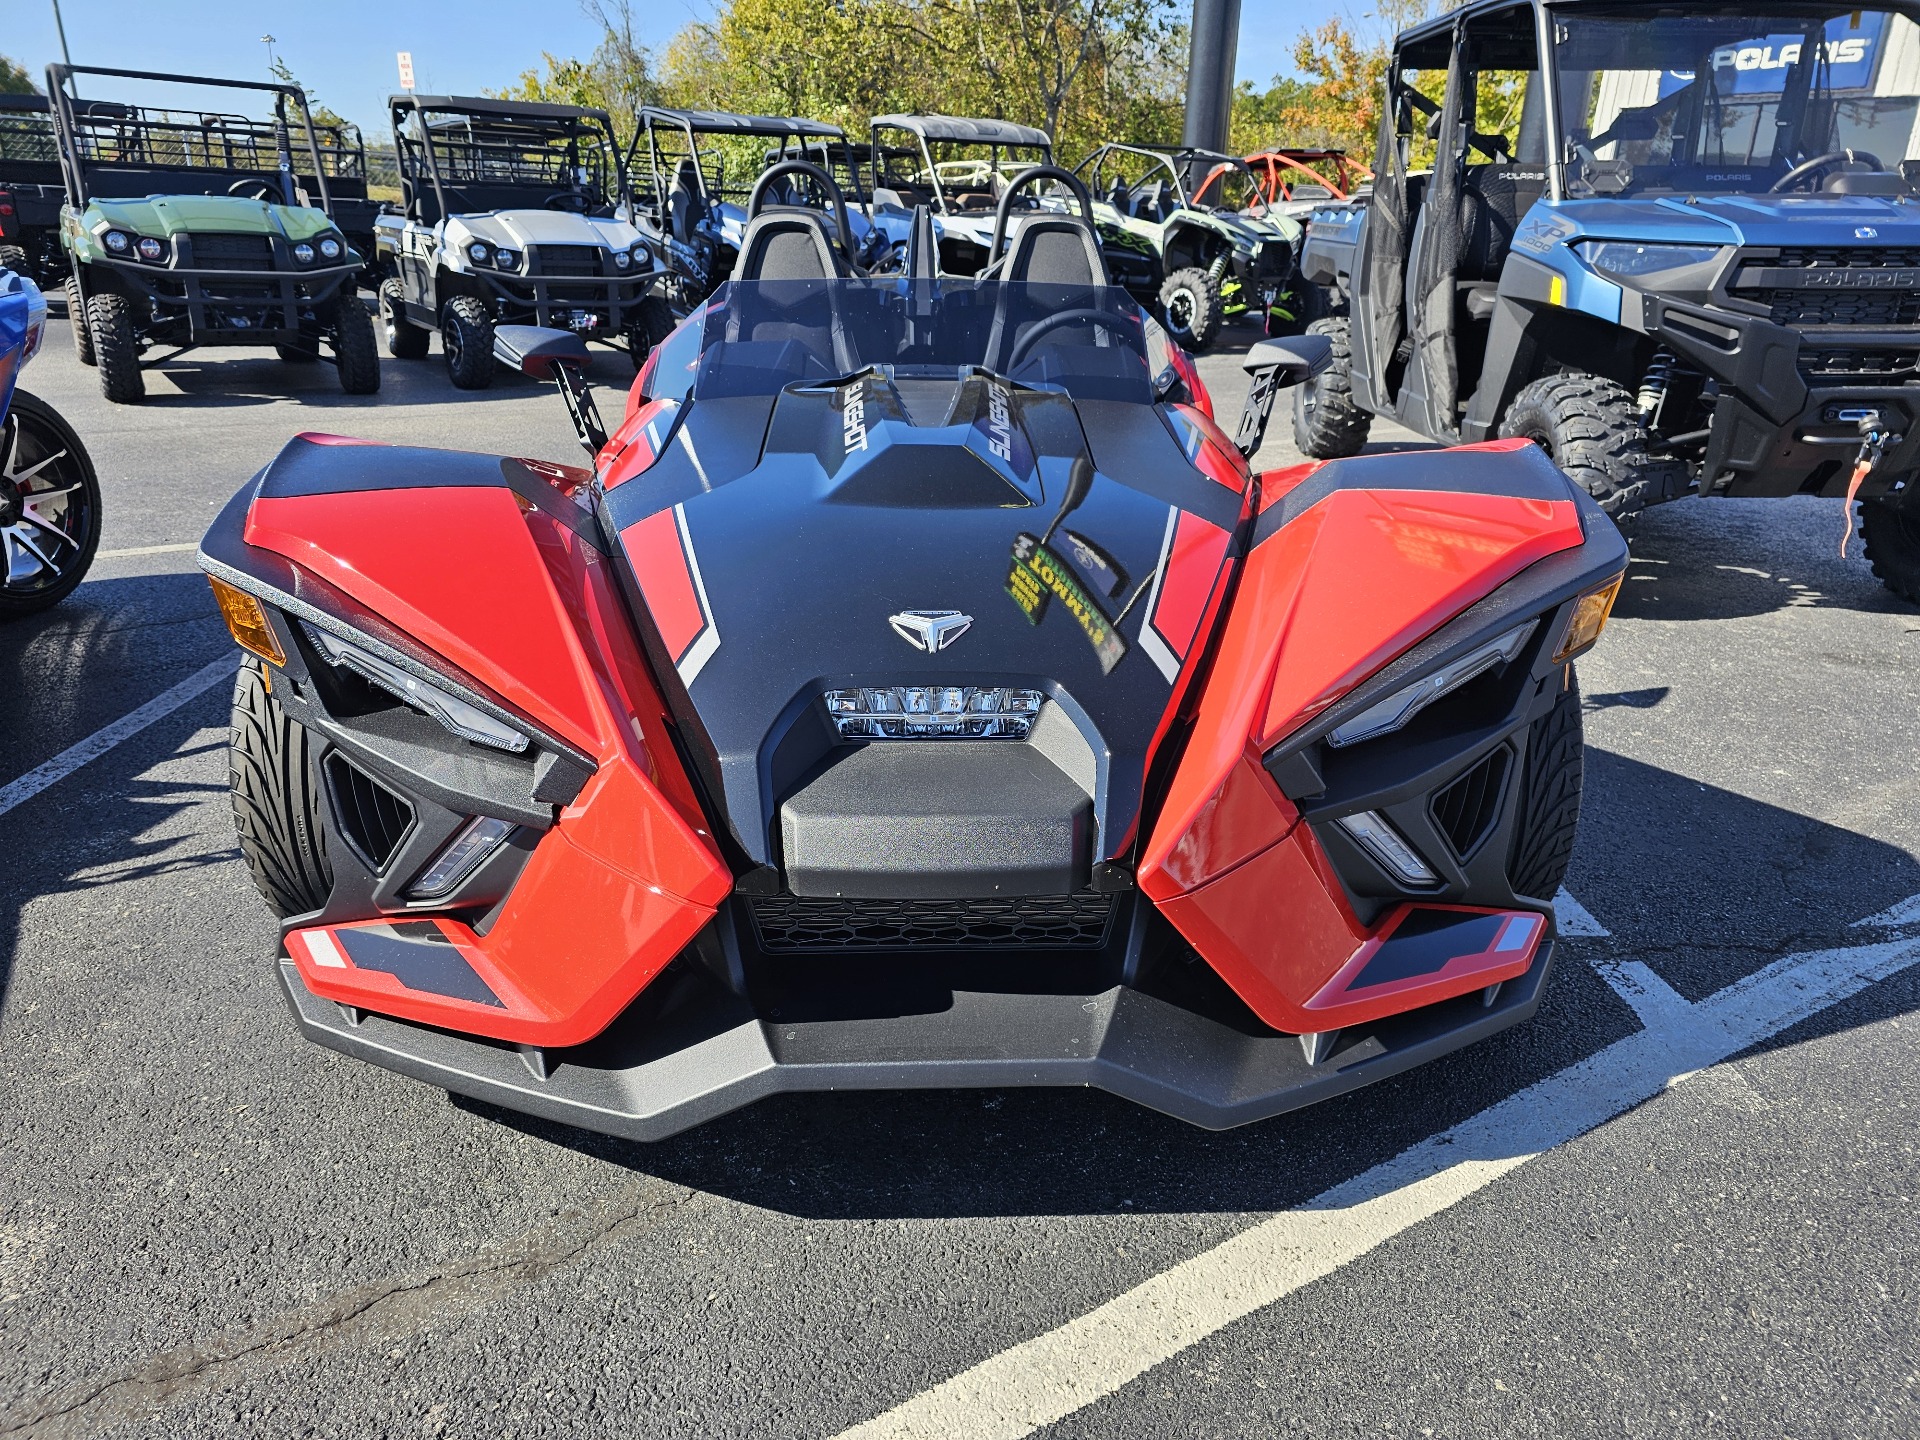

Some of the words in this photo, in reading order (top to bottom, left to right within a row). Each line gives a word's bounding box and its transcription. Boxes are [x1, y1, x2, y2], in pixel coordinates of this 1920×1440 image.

[1498, 172, 1546, 180] POLARIS
[1525, 219, 1566, 238] XP
[1523, 236, 1552, 252] 1000
[1802, 271, 1915, 287] POLARIS
[844, 381, 869, 454] SLINGSHOT
